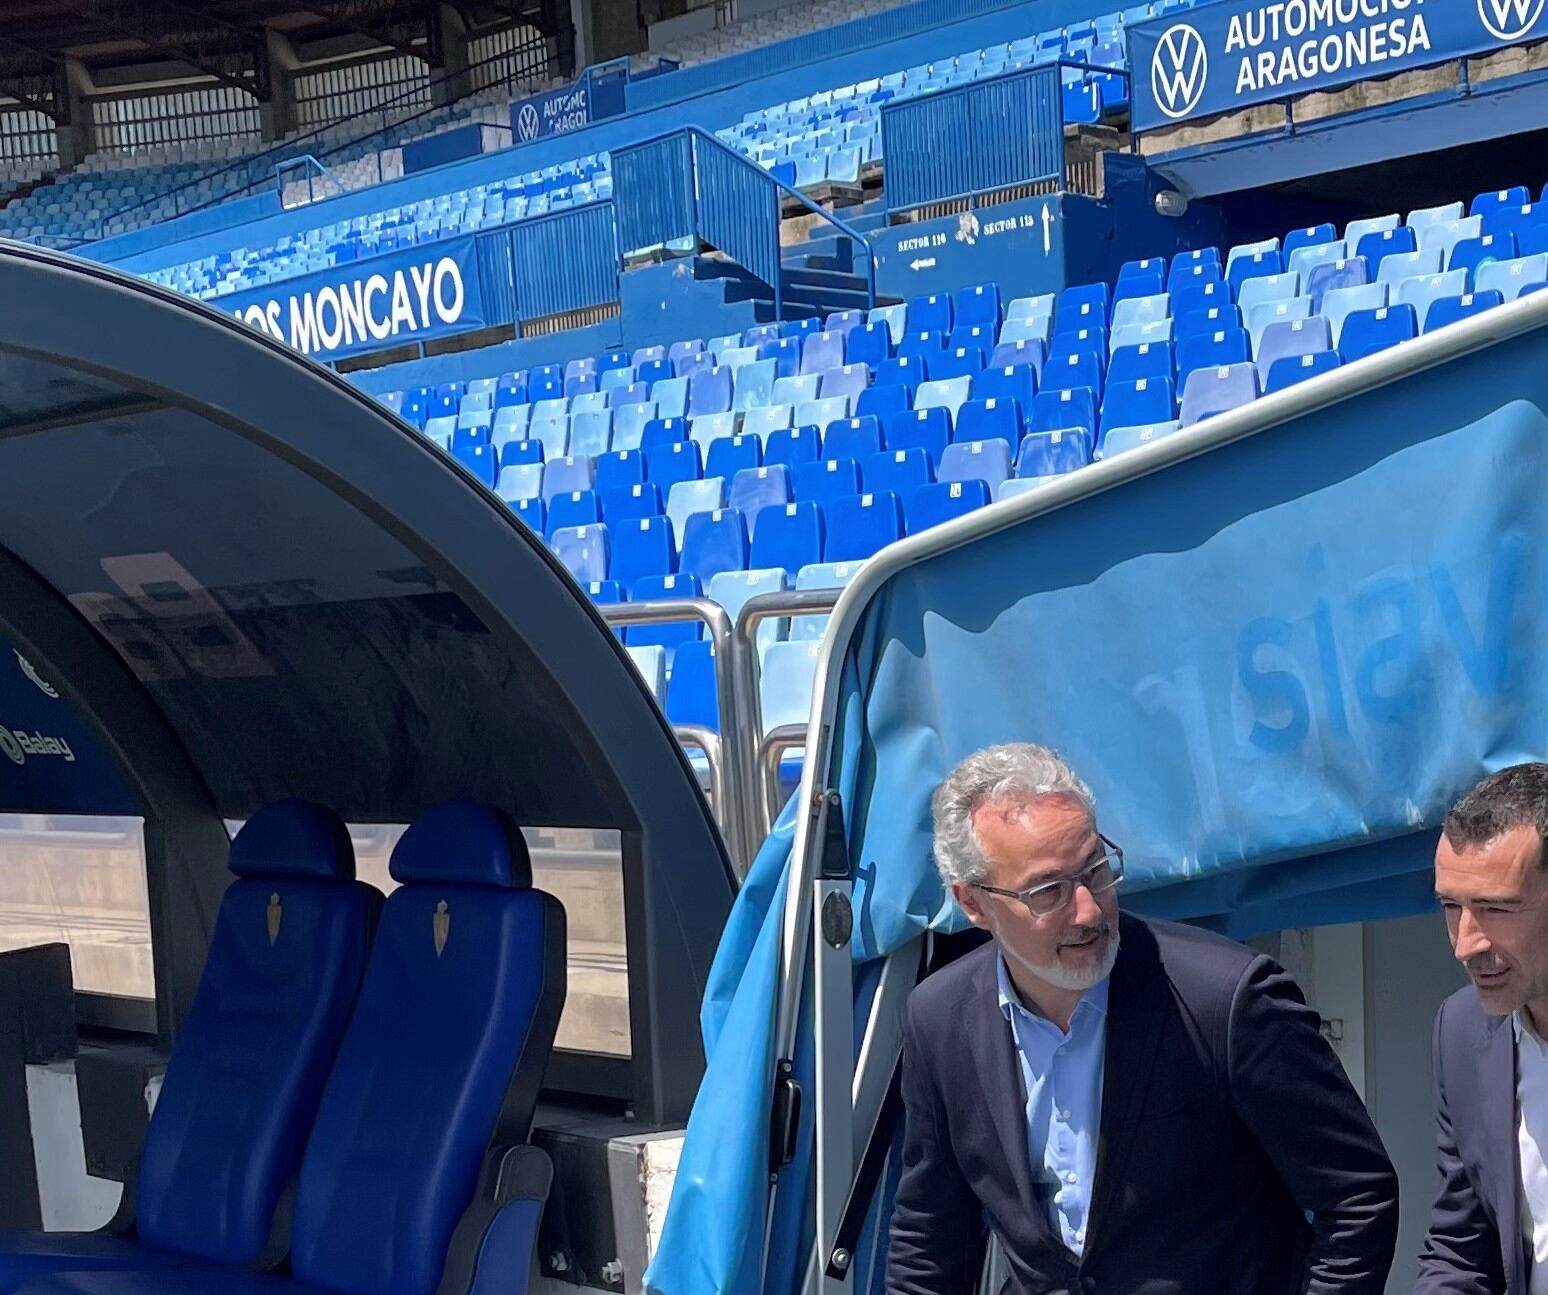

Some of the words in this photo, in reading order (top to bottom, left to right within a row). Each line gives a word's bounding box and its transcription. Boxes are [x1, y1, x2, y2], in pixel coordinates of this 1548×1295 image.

[1236, 14, 1431, 94] ARAGONESA
[984, 217, 1017, 236] SECTOR
[898, 235, 930, 252] SECTOR
[290, 257, 464, 354] MONCAYO
[13, 730, 75, 761] Balay
